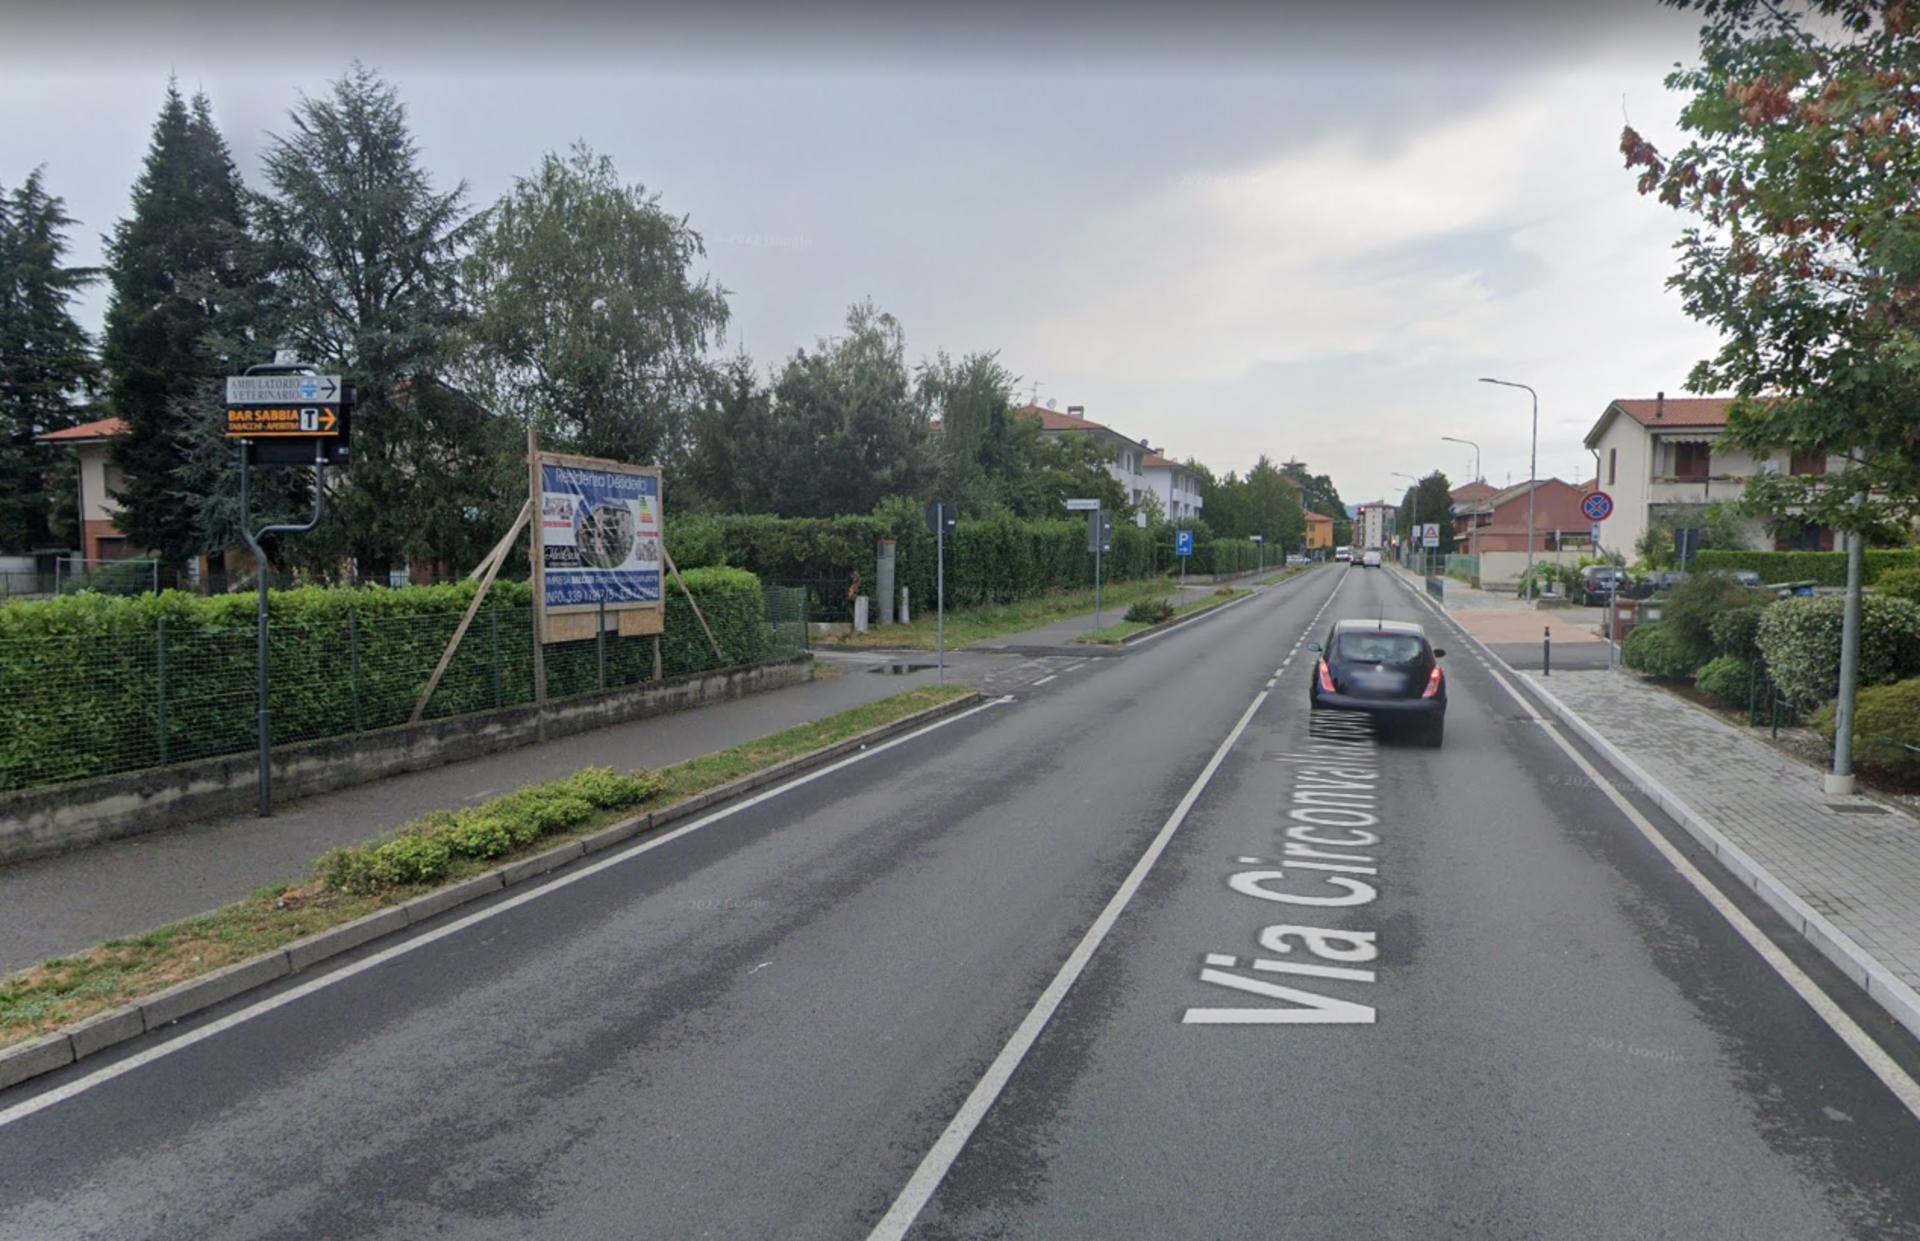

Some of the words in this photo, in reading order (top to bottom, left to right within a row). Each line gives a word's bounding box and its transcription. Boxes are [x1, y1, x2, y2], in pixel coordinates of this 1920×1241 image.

[231, 378, 300, 389] AMBULATORIO
[232, 390, 300, 401] VETERINARIO
[228, 410, 251, 421] BAR
[254, 410, 299, 421] SABBIA
[304, 410, 315, 429] T
[555, 468, 605, 487] Residenza
[1179, 532, 1189, 546] P
